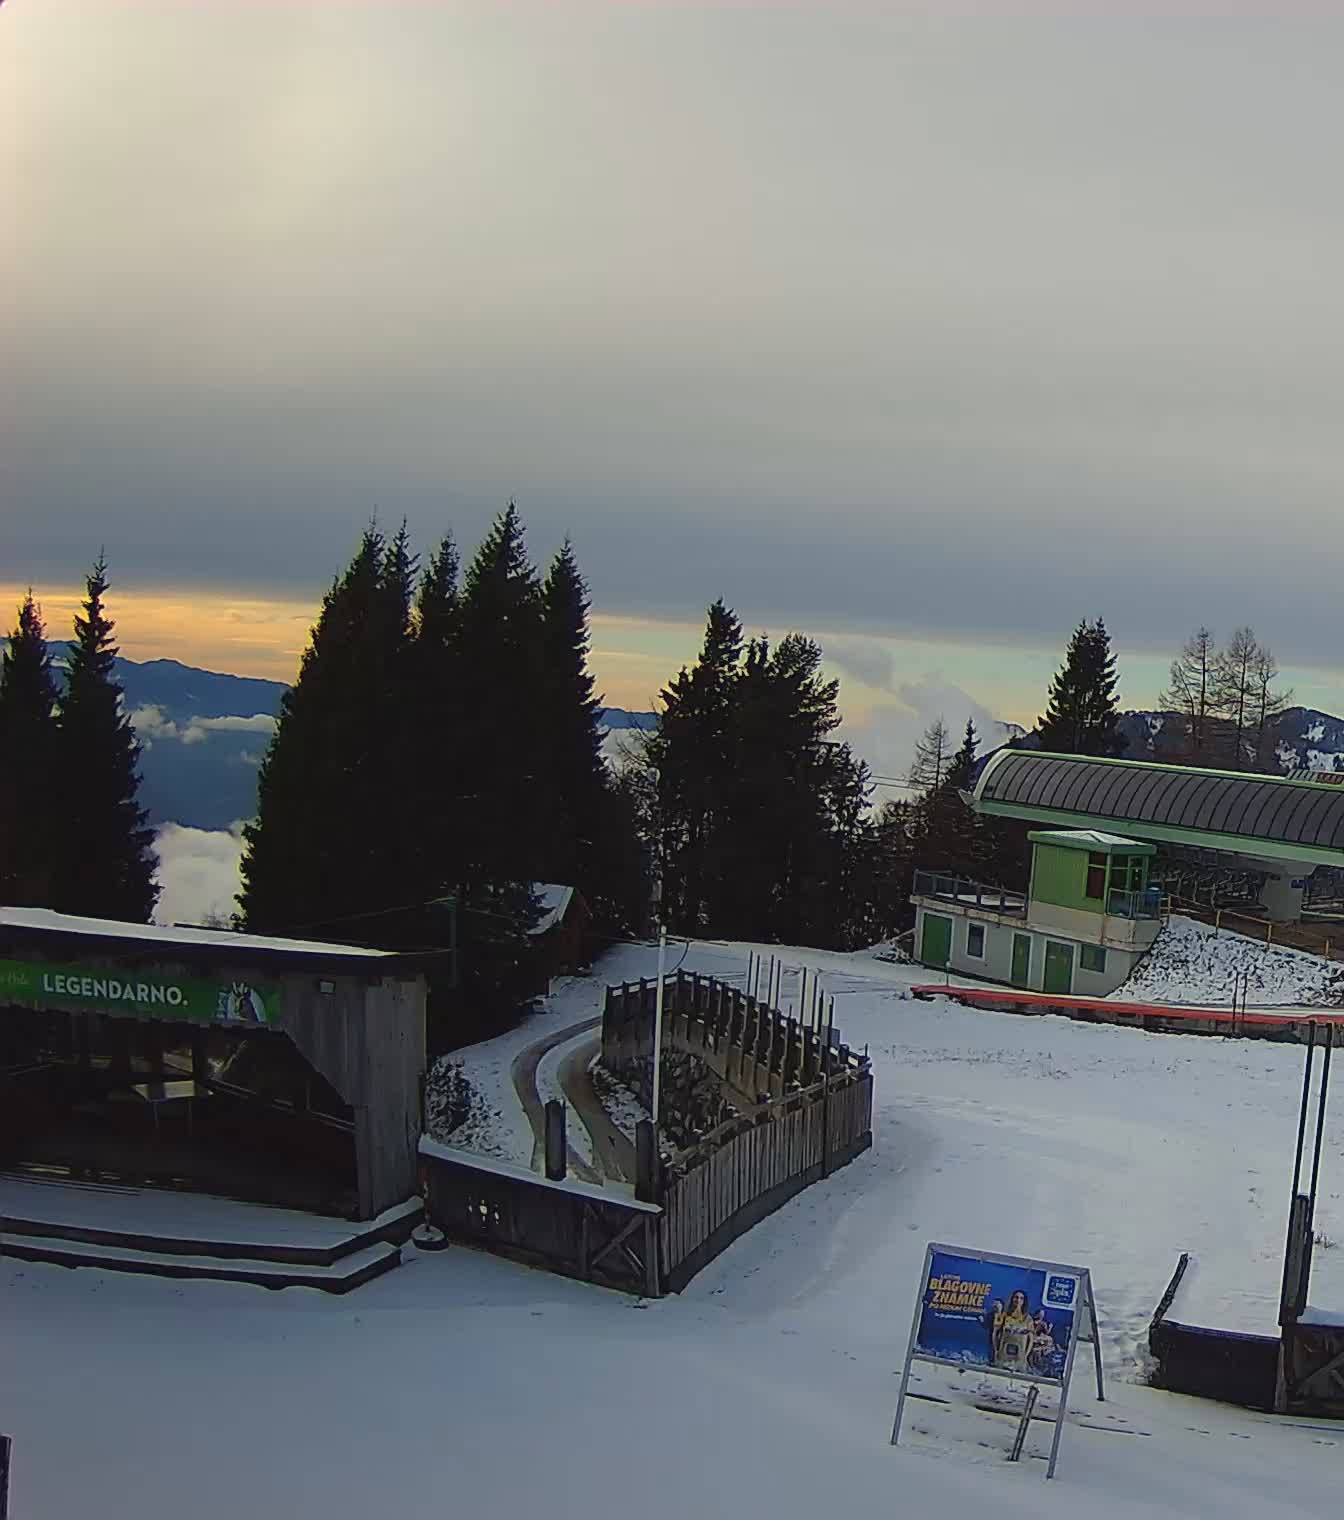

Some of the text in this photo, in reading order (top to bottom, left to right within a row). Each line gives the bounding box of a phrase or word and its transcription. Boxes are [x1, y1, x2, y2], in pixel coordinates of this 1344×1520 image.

[43, 973, 189, 1006] LEGENDARNO.
[928, 1278, 992, 1296] BLAGOVNE
[932, 1290, 985, 1307] ZNAMKE
